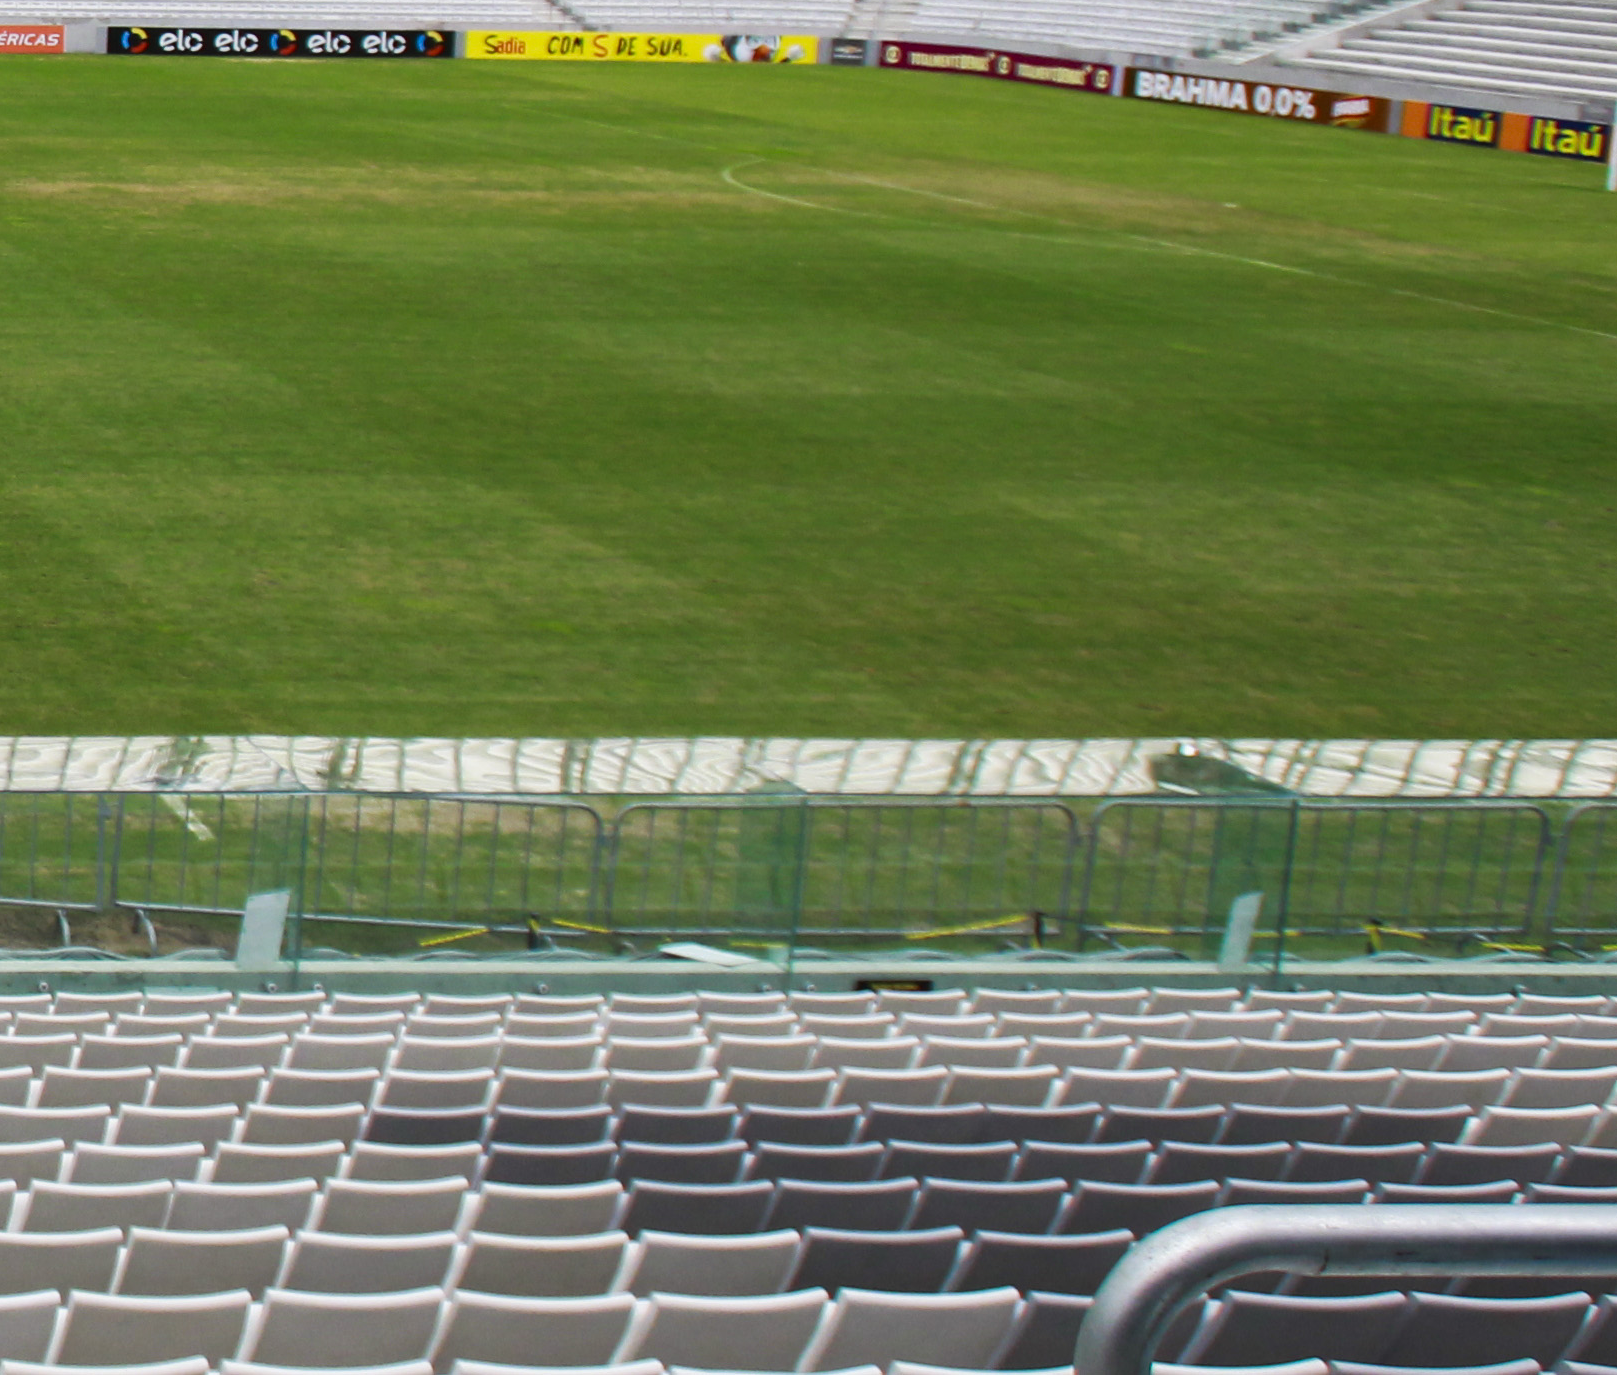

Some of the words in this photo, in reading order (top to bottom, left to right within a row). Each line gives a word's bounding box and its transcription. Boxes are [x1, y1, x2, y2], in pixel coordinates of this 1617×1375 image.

[484, 34, 526, 56] Sadia
[547, 36, 584, 55] COM
[593, 35, 608, 59] S
[617, 36, 637, 56] DE
[1134, 70, 1248, 111] BRAHMA
[1431, 105, 1495, 144] Itaú
[1532, 119, 1604, 158] Itaú
